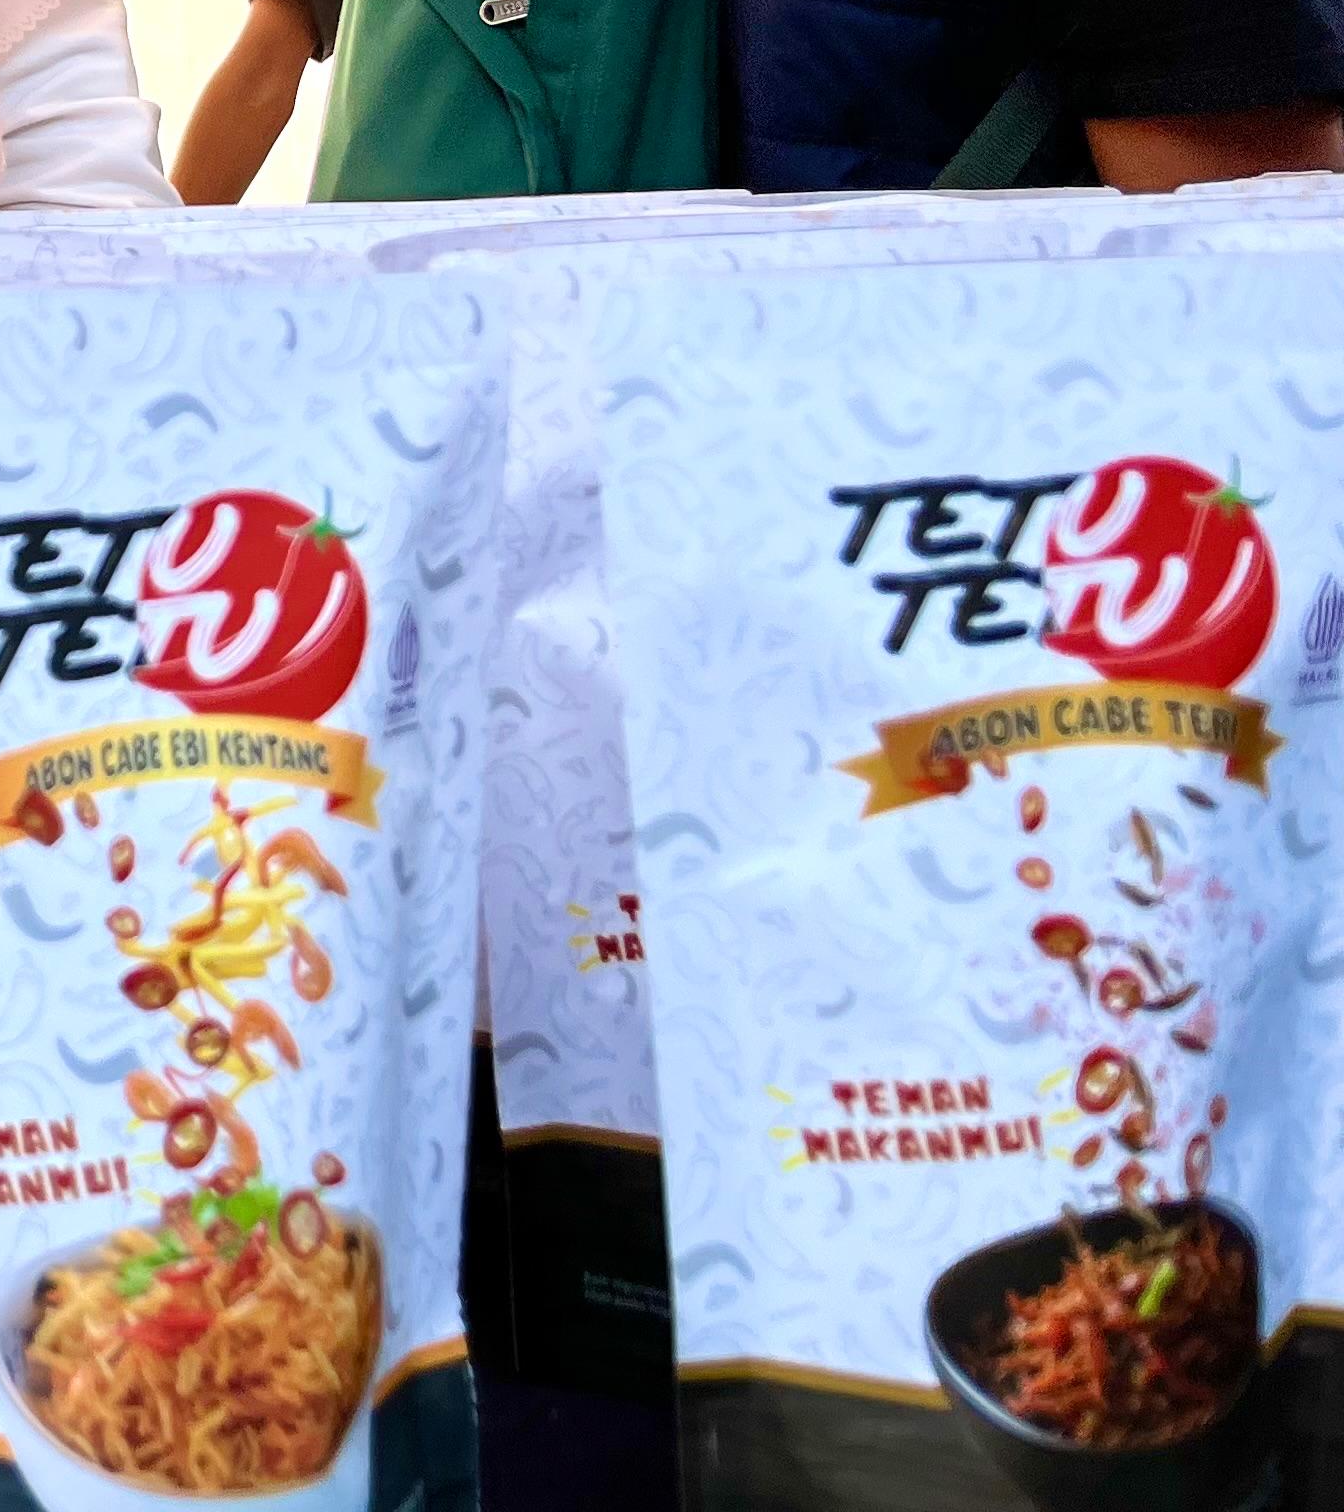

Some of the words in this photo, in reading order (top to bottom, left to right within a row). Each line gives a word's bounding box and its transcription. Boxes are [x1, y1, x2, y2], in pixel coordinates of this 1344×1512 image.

[932, 702, 1041, 761] ABON
[1054, 695, 1153, 737] CABE
[25, 745, 93, 792] ABON
[101, 731, 161, 777] CABE
[170, 728, 208, 768] EBI
[216, 729, 329, 775] KENTANG
[831, 1075, 990, 1117] TEMAN
[802, 1115, 1046, 1162] MAKANMU!
